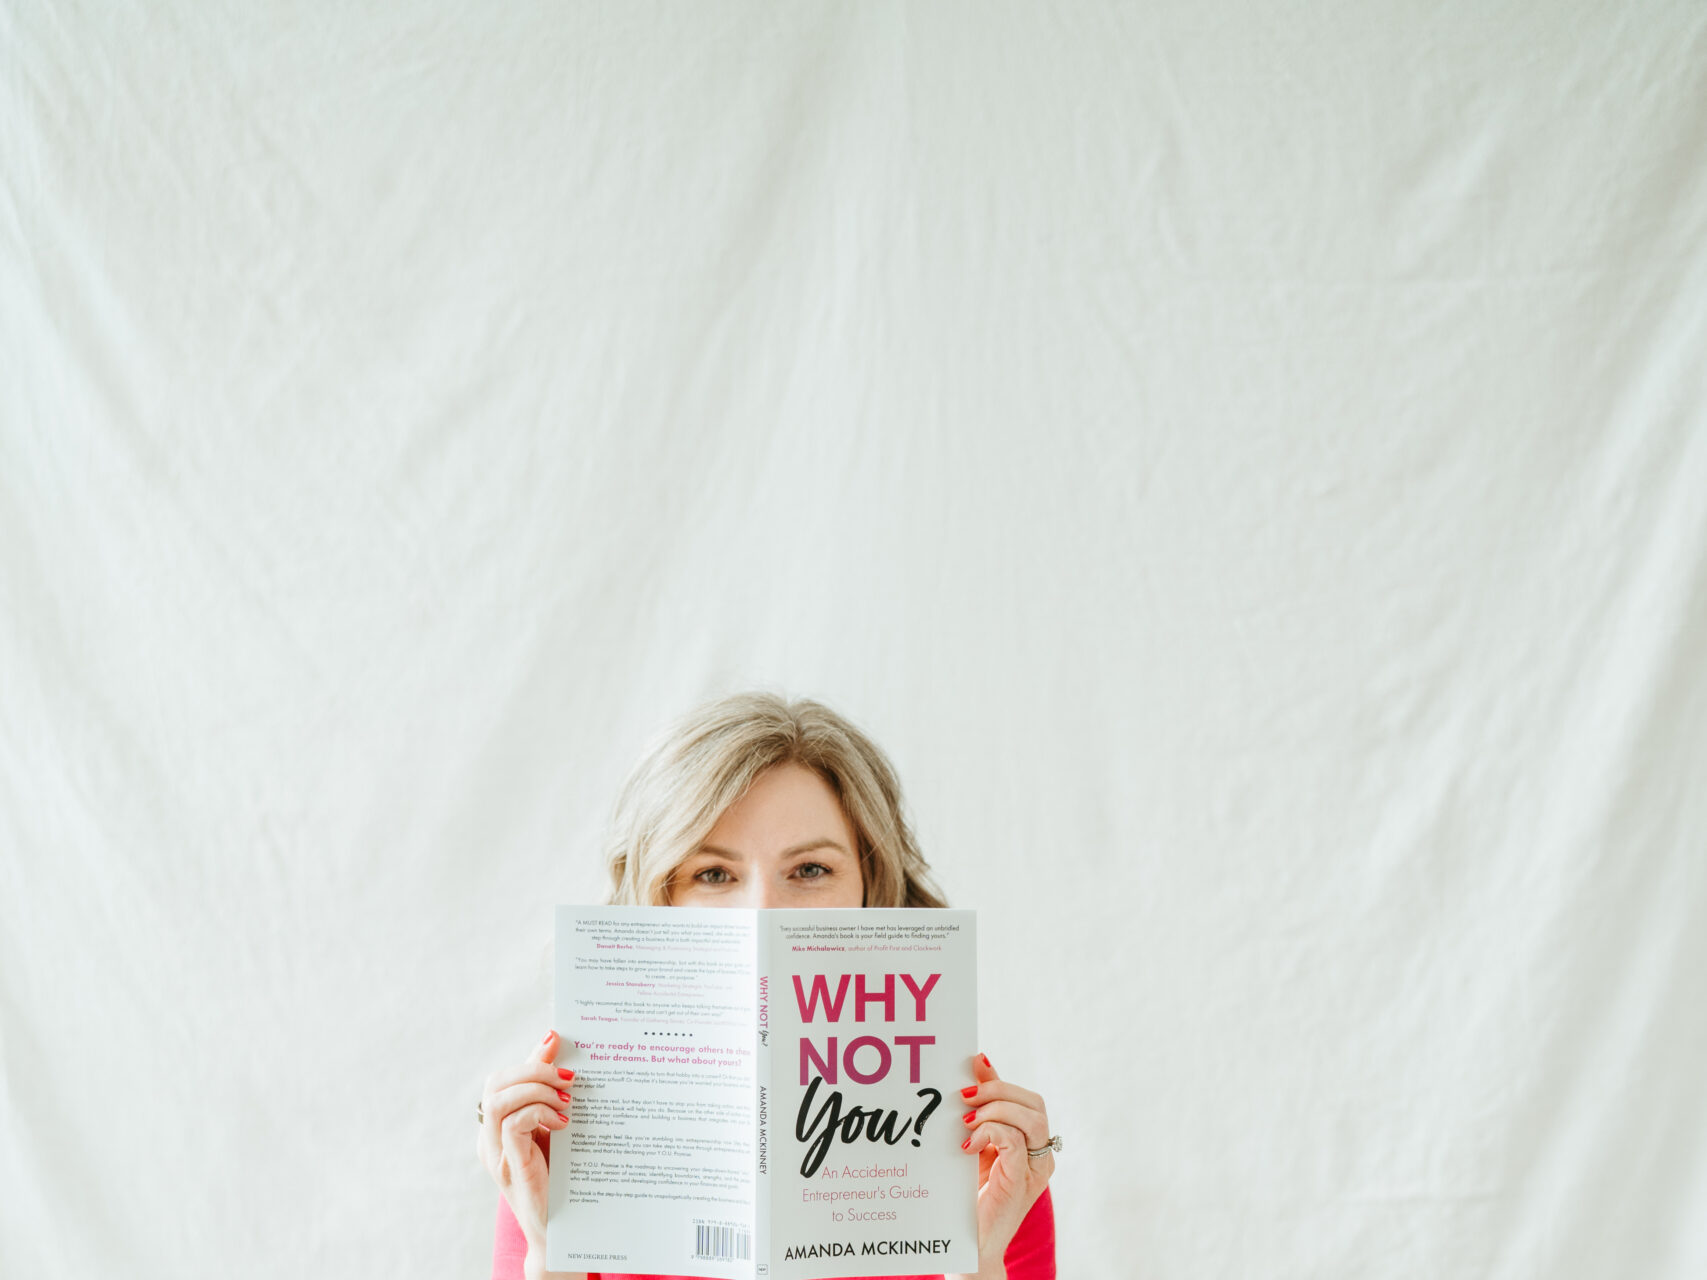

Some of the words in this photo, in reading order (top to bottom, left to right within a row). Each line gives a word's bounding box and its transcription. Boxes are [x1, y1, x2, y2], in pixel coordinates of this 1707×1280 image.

[760, 976, 768, 1002] WHY
[792, 974, 942, 1023] WHY
[760, 1004, 768, 1028] NOT
[574, 1041, 605, 1049] You're
[608, 1042, 634, 1052] ready
[649, 1046, 695, 1054] encourage
[698, 1045, 723, 1054] others
[726, 1047, 734, 1055] to
[590, 1053, 610, 1061] their
[612, 1054, 648, 1062] dreams.
[668, 1056, 690, 1064] what
[692, 1056, 716, 1065] about
[718, 1059, 742, 1068] yours?
[800, 1036, 936, 1086] NOT
[760, 1086, 768, 1126] AMANDA
[796, 1076, 942, 1178] You?
[760, 1128, 768, 1175] MCKINNEY
[822, 1166, 838, 1179] An
[842, 1164, 908, 1178] Accidental
[802, 1186, 886, 1204] Entrepreneur's
[890, 1184, 929, 1199] Guide
[832, 1210, 844, 1222] to
[848, 1208, 897, 1222] Success
[784, 1242, 856, 1261] AMANDA
[861, 1240, 951, 1256] MCKINNEY
